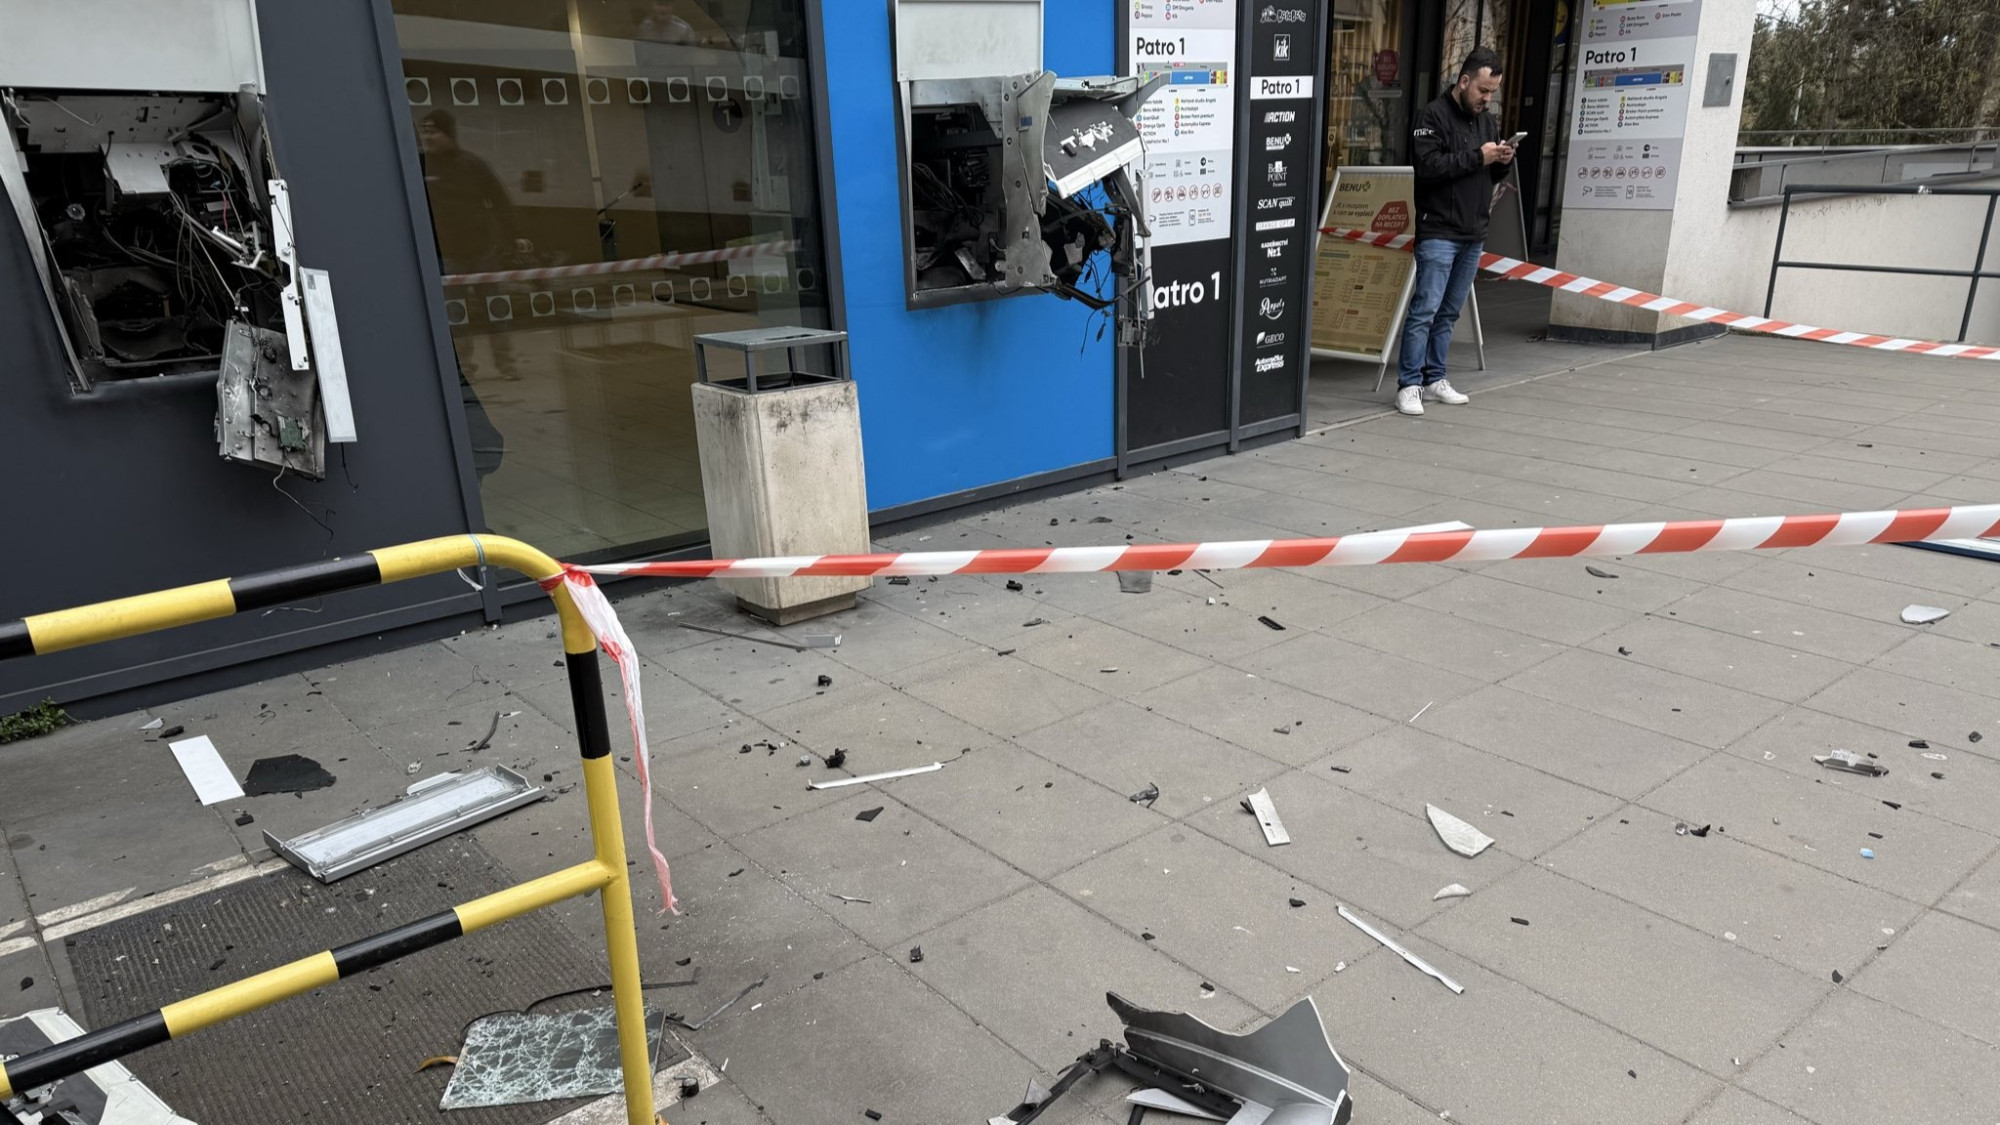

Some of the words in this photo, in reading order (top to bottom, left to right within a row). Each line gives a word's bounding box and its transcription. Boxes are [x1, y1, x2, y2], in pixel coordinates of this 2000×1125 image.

[1137, 37, 1175, 55] Patro
[1179, 37, 1185, 55] 1
[1585, 48, 1625, 65] Patro
[1630, 47, 1637, 62] 1
[1261, 79, 1292, 95] Patro
[1295, 78, 1300, 94] 1
[1267, 111, 1296, 123] ACTION
[1266, 136, 1284, 146] BENU
[1339, 182, 1362, 192] BENU
[1257, 198, 1278, 210] SCAN
[1154, 278, 1204, 310] atro
[1211, 271, 1220, 300] 1
[1264, 332, 1285, 344] GECO
